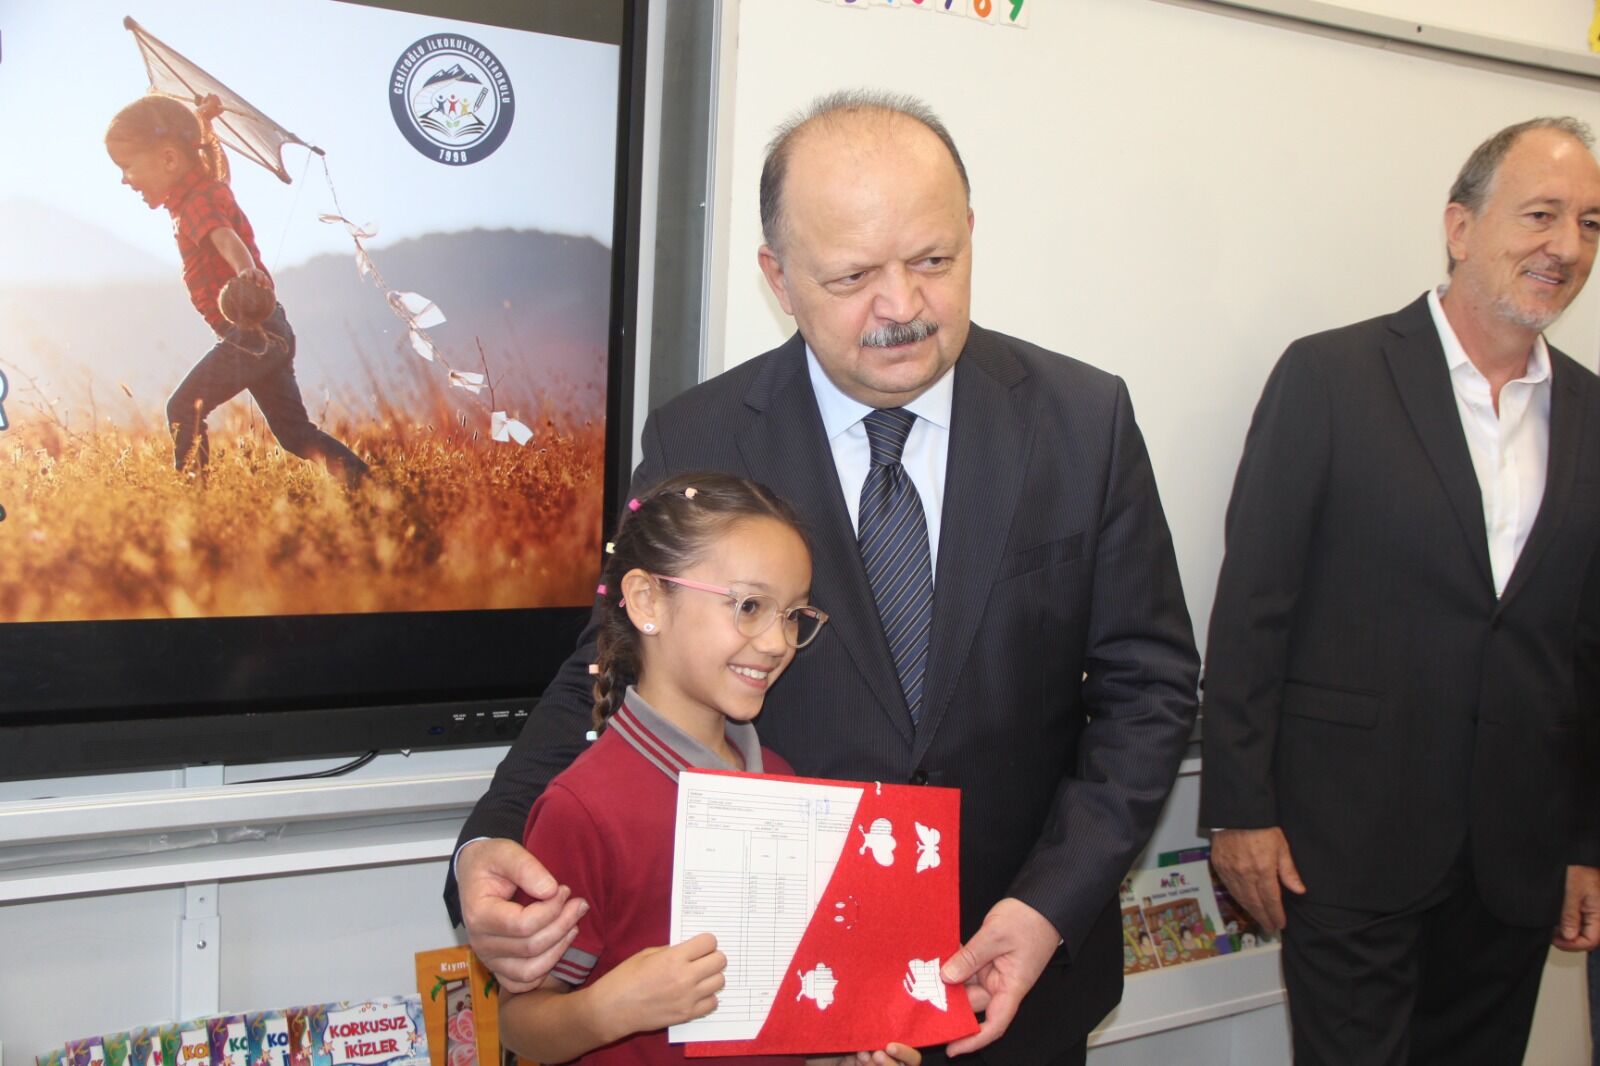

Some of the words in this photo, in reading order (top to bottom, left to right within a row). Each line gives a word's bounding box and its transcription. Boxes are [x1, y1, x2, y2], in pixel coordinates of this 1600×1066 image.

[426, 38, 510, 103] İLKOKULU/ORTAOKULU
[329, 1016, 408, 1039] KORKUSUZ
[344, 1038, 400, 1060] İKİZLER
